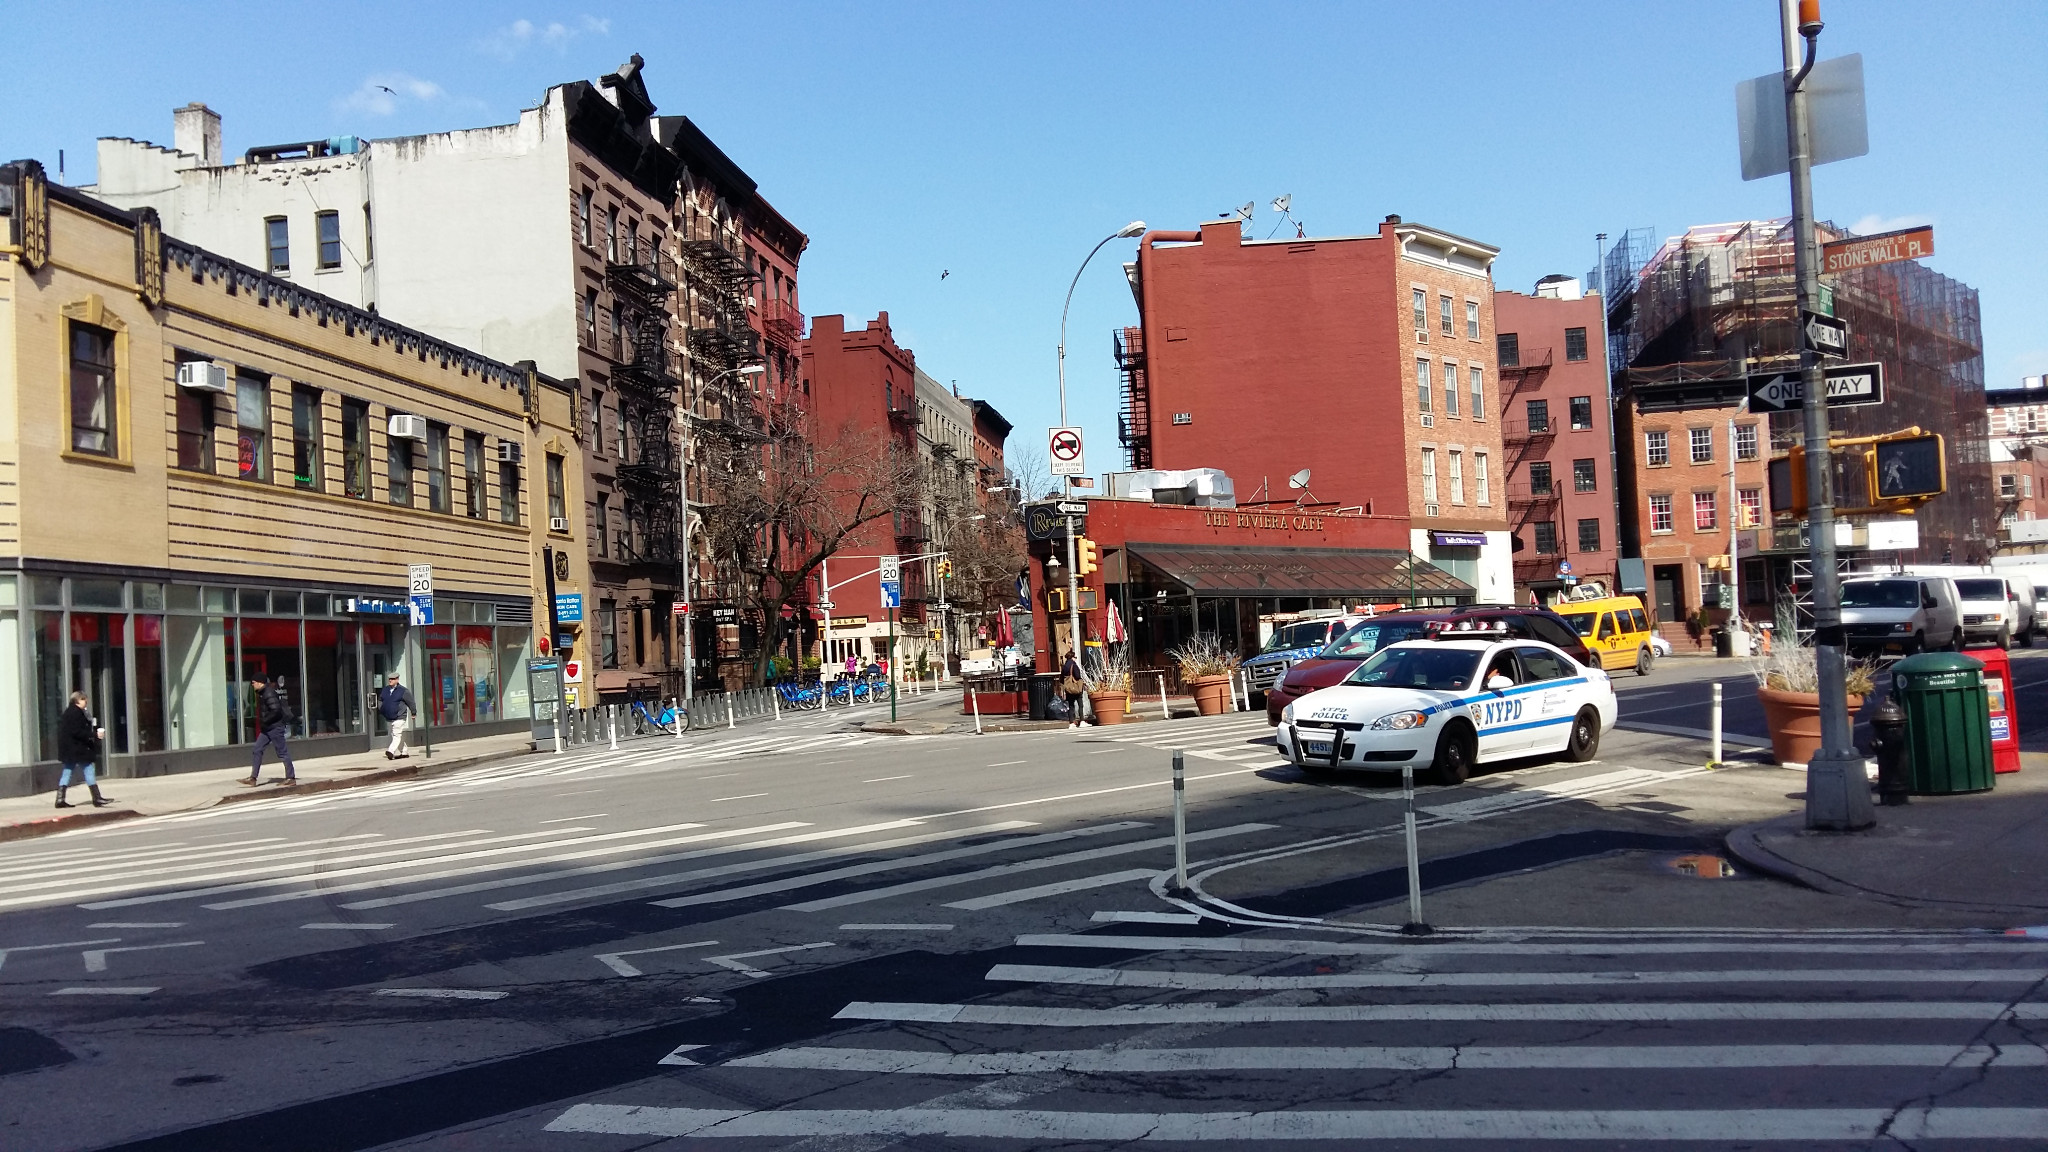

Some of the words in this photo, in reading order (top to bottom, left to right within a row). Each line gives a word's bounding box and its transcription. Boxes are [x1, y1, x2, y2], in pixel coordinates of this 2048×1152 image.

[1845, 236, 1895, 253] CHRISTOPHER
[1897, 234, 1907, 244] ST
[1828, 244, 1904, 270] STONEWALL
[1908, 240, 1926, 257] PL
[1811, 324, 1826, 342] ONE
[1827, 328, 1843, 347] WAY
[1768, 383, 1803, 400] ONE
[1825, 377, 1863, 395] WAY
[1204, 512, 1230, 527] THE
[1236, 514, 1289, 530] RIVIERA
[1293, 516, 1323, 531] CAFE
[883, 569, 897, 579] 20
[413, 579, 430, 591] 20
[1928, 678, 1956, 686] Beautiful
[1434, 701, 1452, 713] POLICE
[1484, 699, 1523, 725] NYPD
[1311, 712, 1349, 720] POLICE
[1990, 718, 2007, 729] OICE
[1310, 742, 1327, 751] 4451
